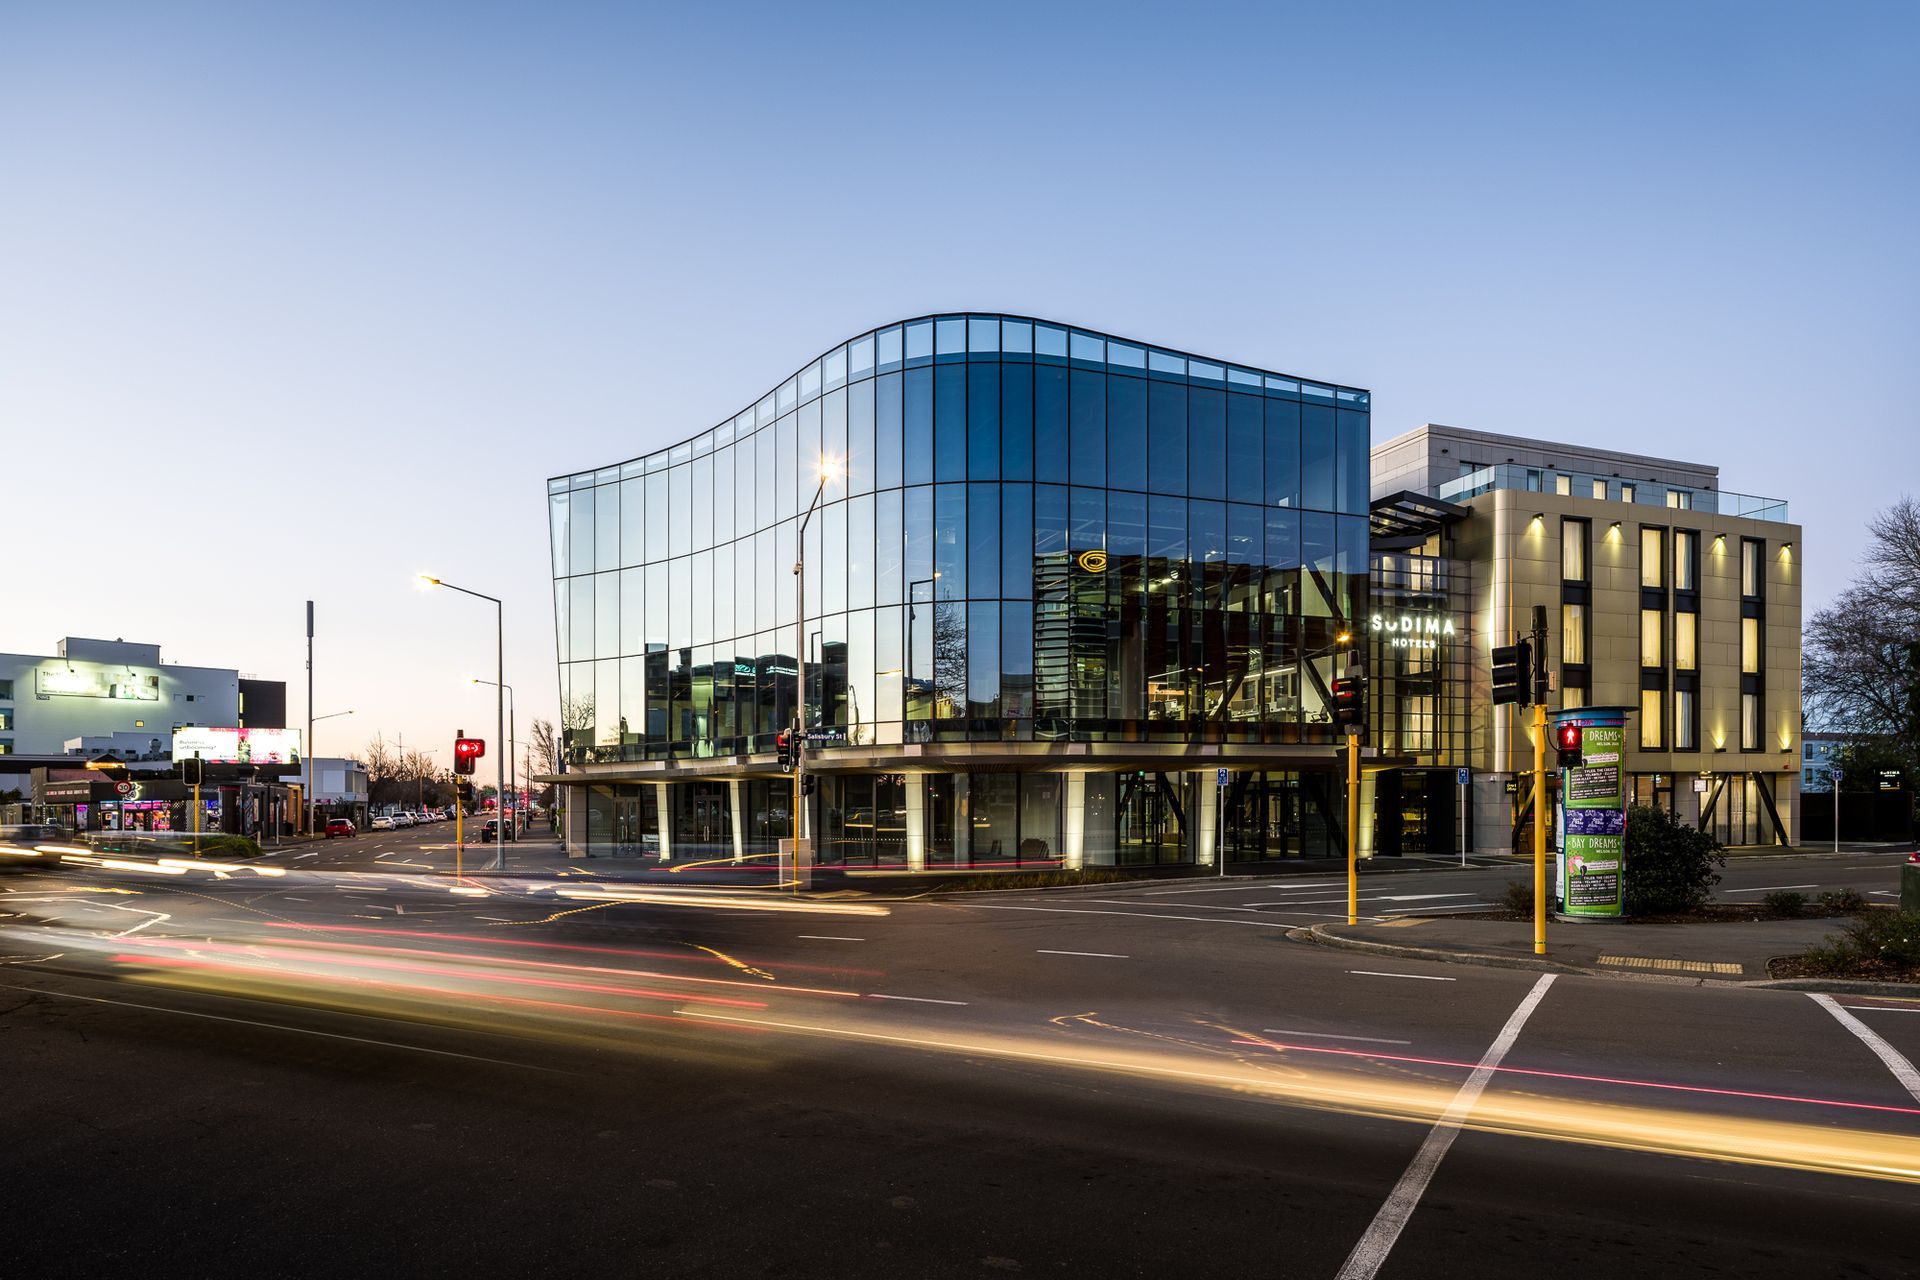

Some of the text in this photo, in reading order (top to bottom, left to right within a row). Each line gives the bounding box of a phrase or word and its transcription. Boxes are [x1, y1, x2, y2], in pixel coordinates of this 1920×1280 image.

[1392, 638, 1436, 648] HOTELS
[1589, 730, 1618, 741] DREAMS
[1571, 837, 1585, 849] BAY
[1589, 837, 1617, 849] DREAMS
